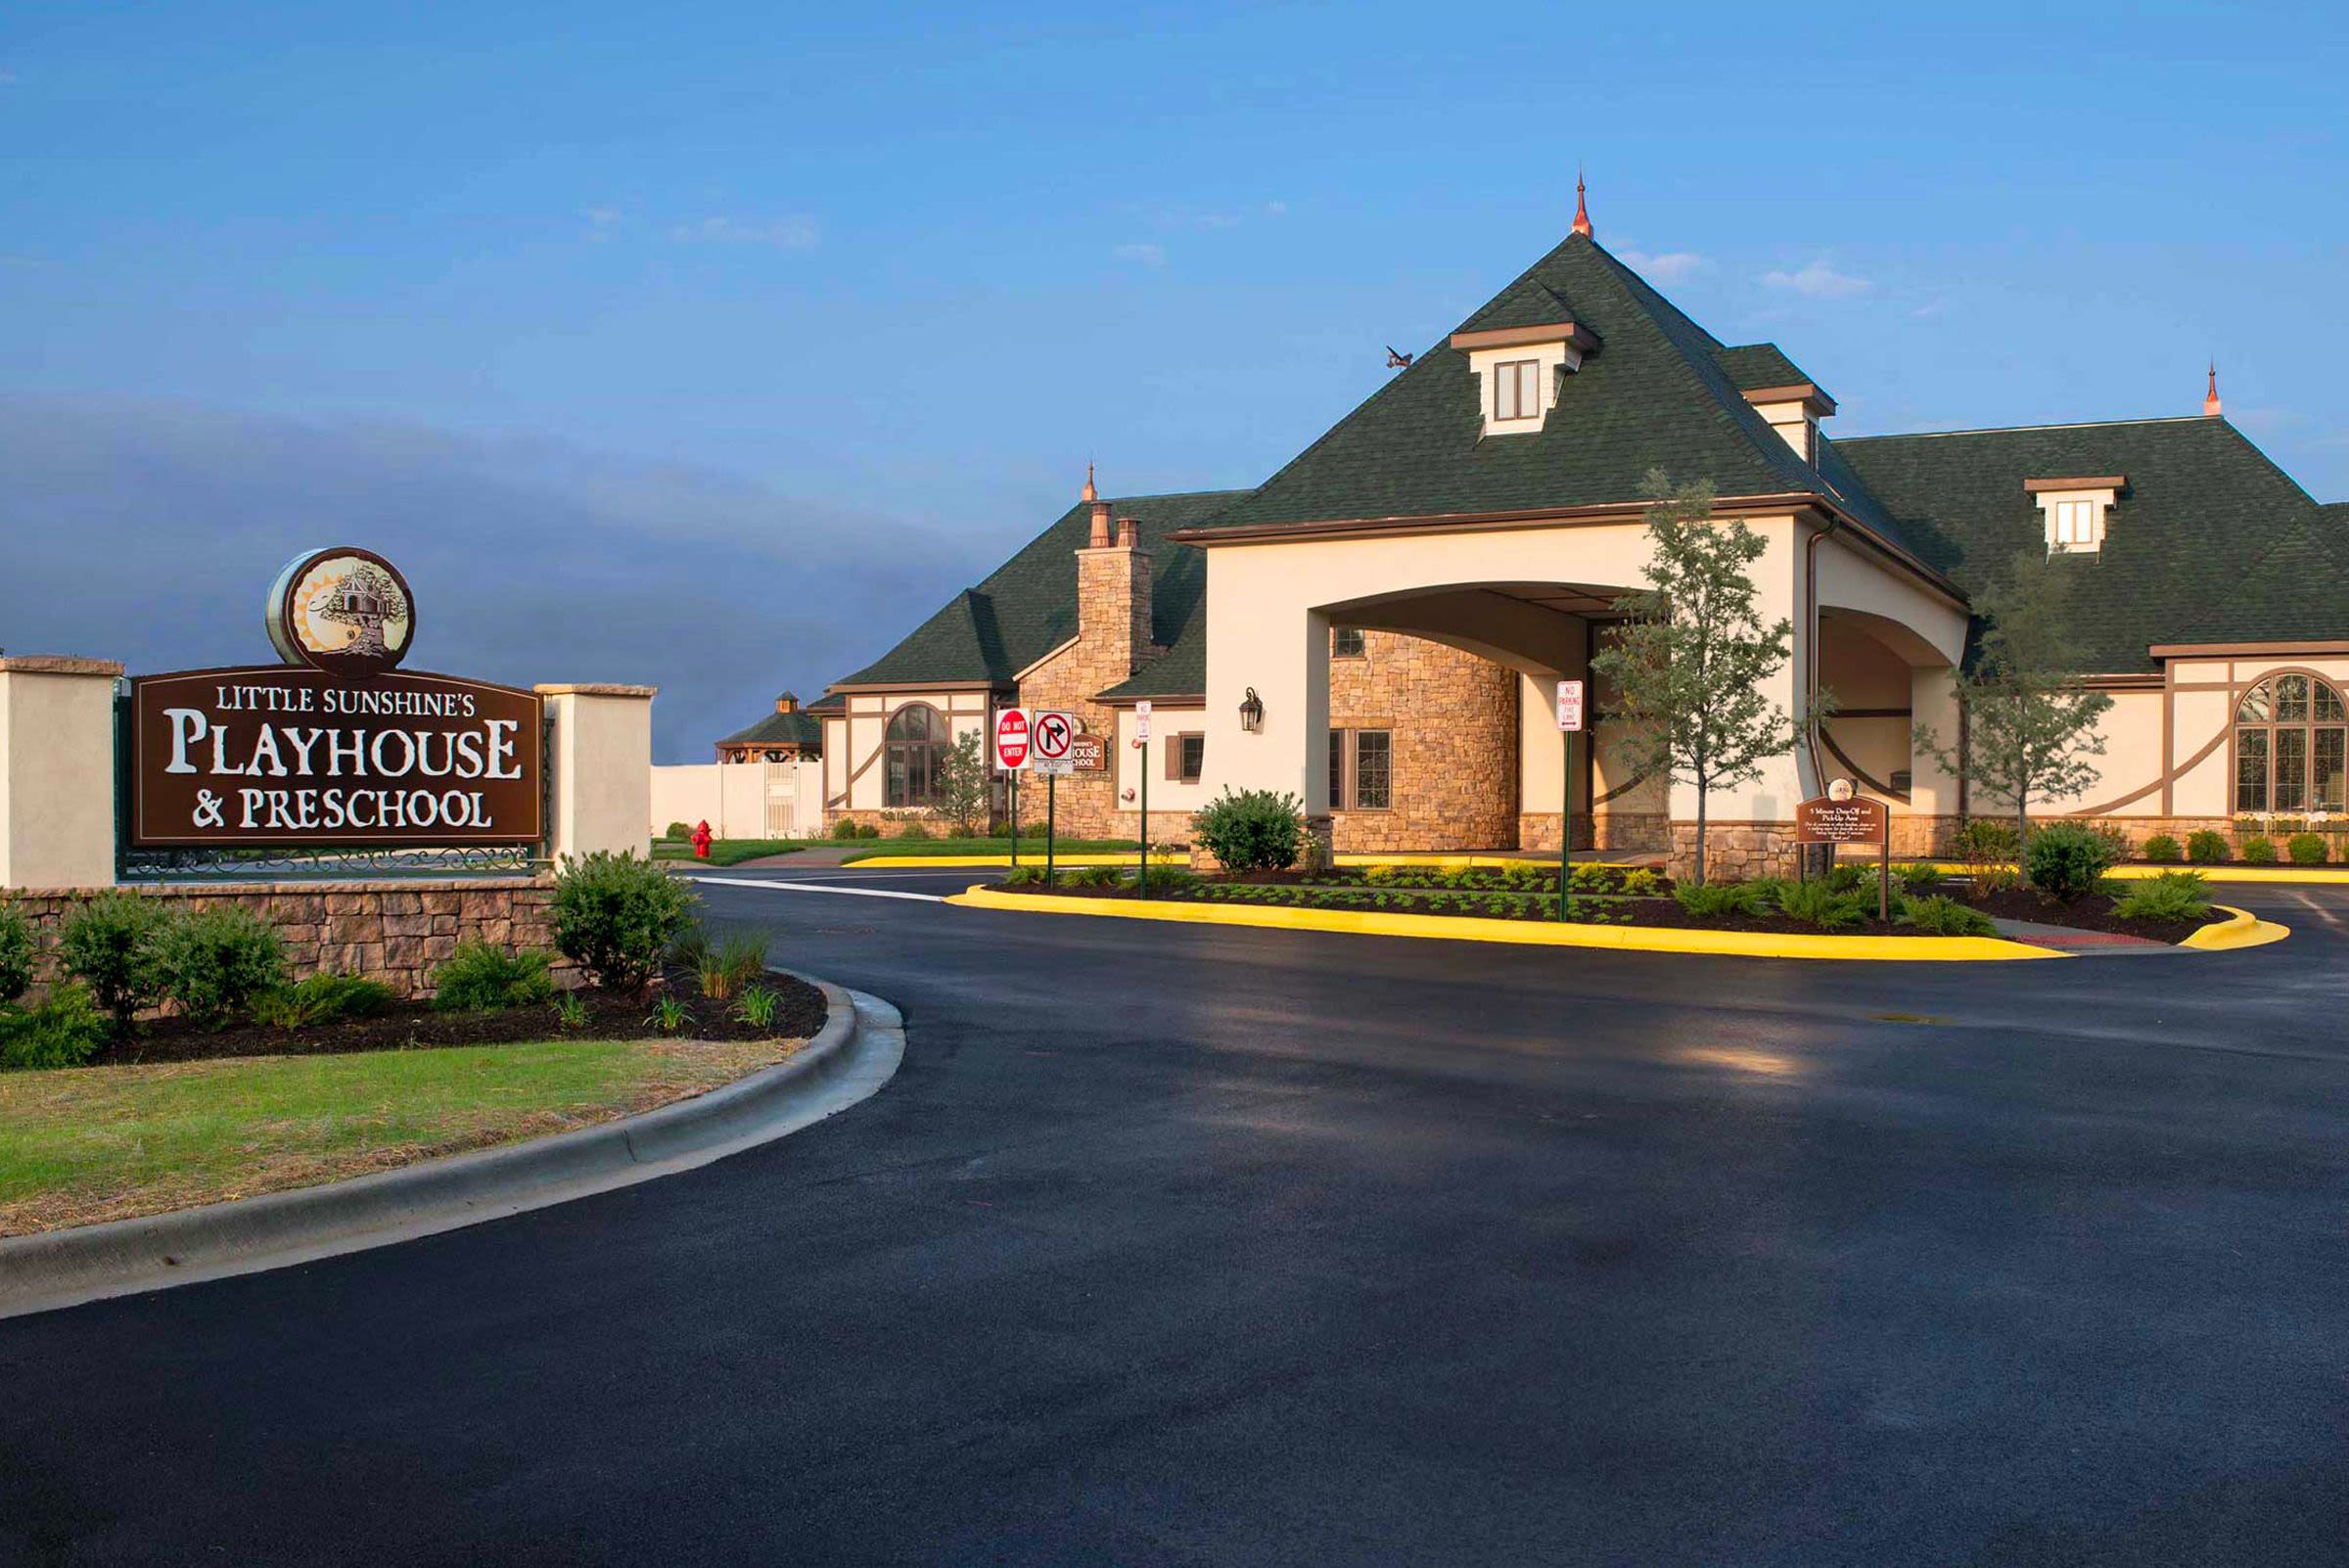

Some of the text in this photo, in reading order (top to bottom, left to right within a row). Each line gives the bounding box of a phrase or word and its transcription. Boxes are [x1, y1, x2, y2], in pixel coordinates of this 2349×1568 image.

[215, 685, 475, 717] LITTLE SUNSHINE'S
[1001, 720, 1025, 731] DO NOT
[162, 708, 522, 780] PLAYHOUSE
[1004, 747, 1023, 758] ENTER
[192, 788, 493, 830] & PRESCHOOL
